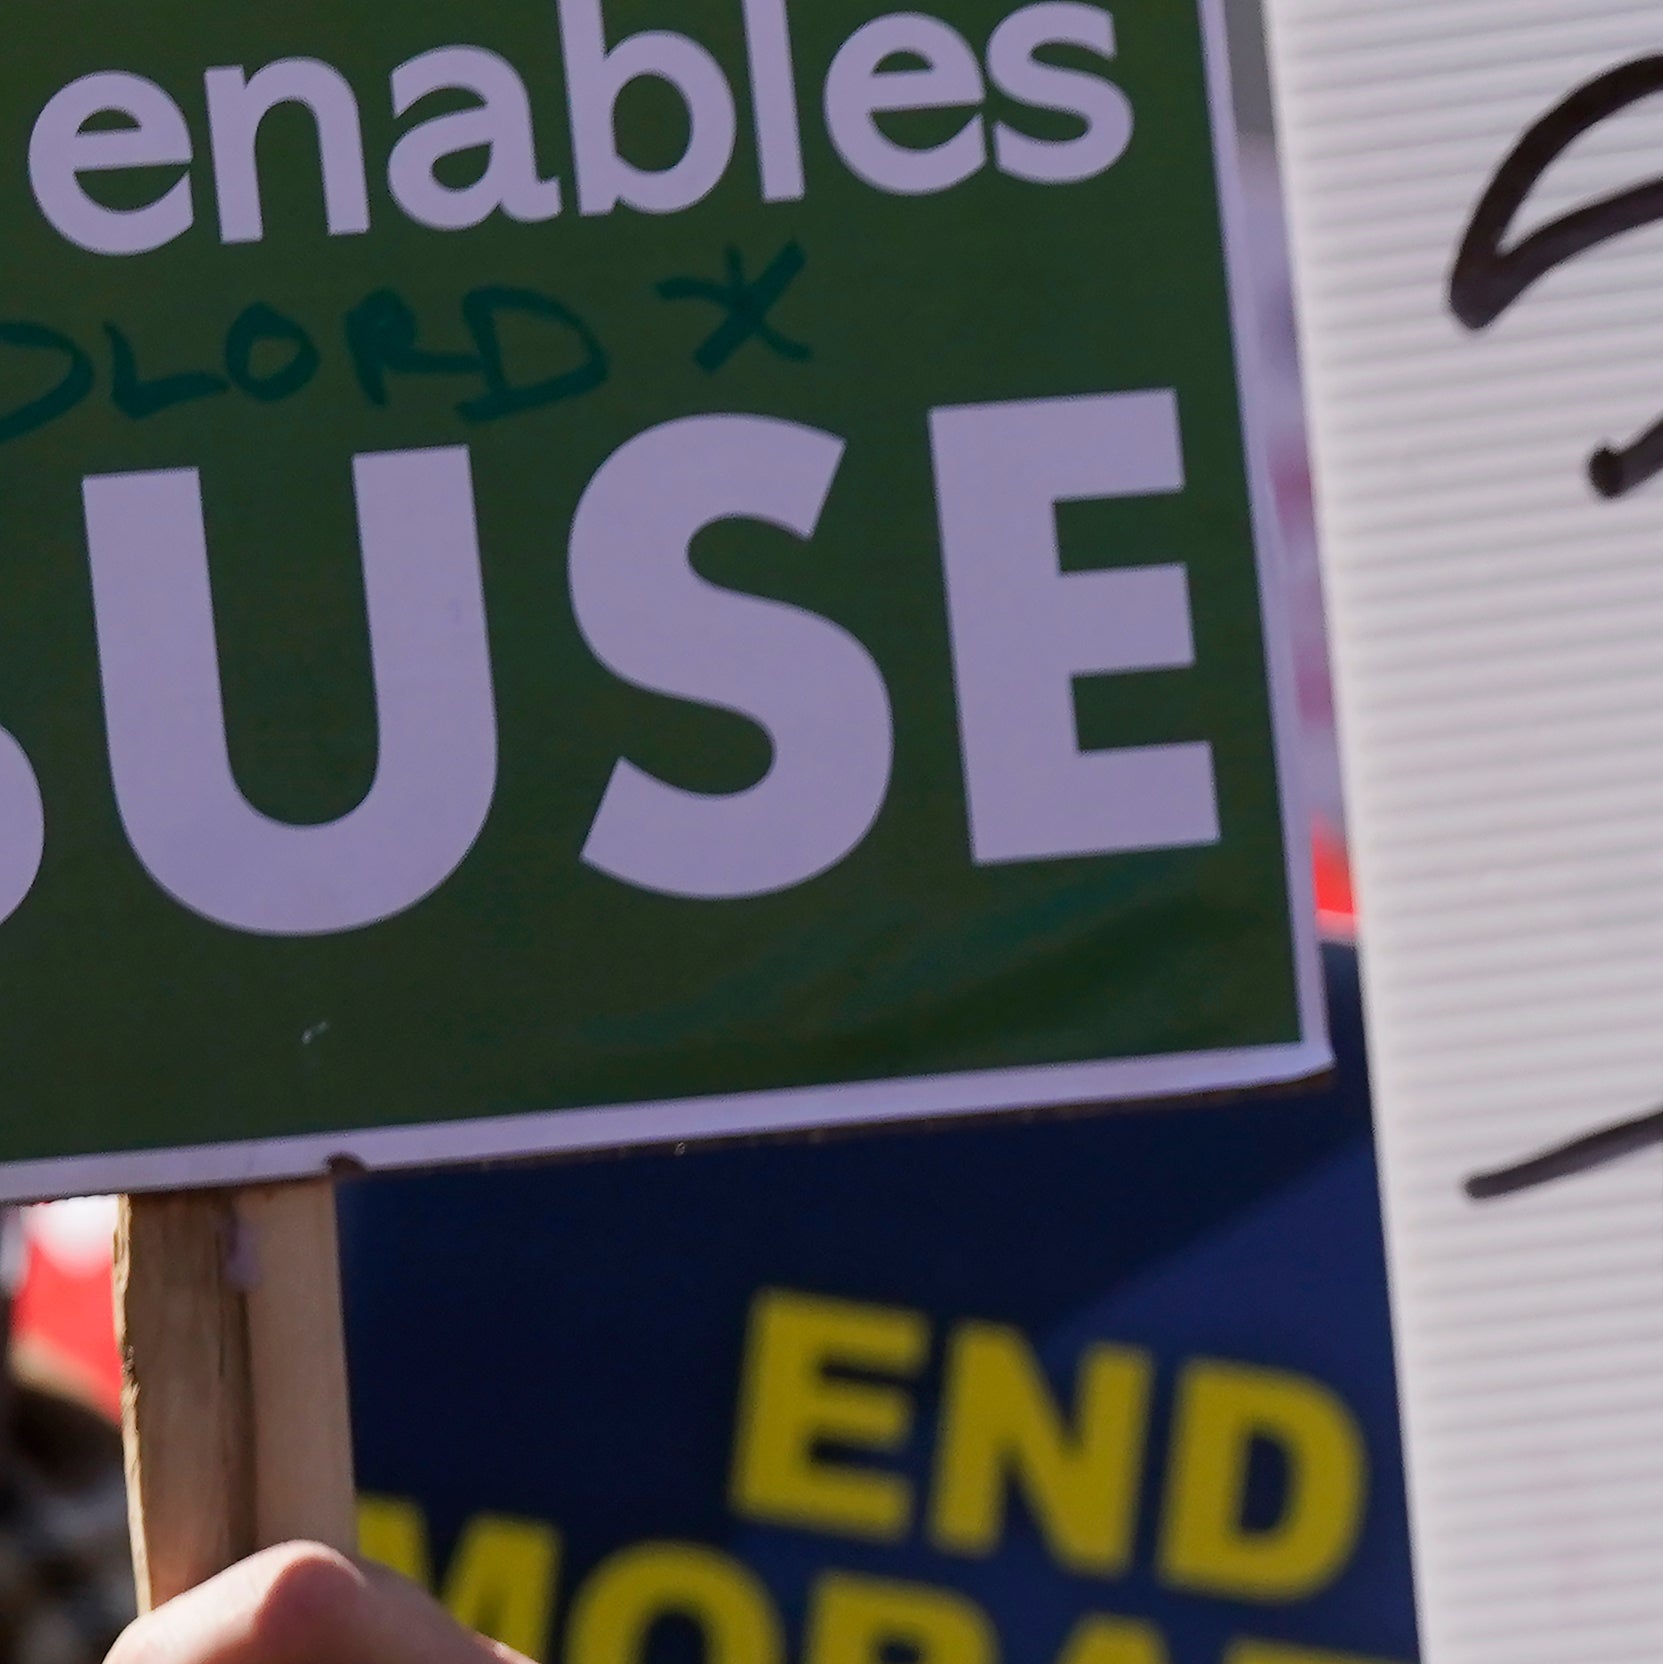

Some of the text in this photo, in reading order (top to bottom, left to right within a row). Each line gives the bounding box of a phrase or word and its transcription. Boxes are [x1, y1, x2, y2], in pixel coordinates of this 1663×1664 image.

[28, 0, 1134, 256] enables
[0, 388, 1221, 938] USE
[728, 1287, 1370, 1598] END
